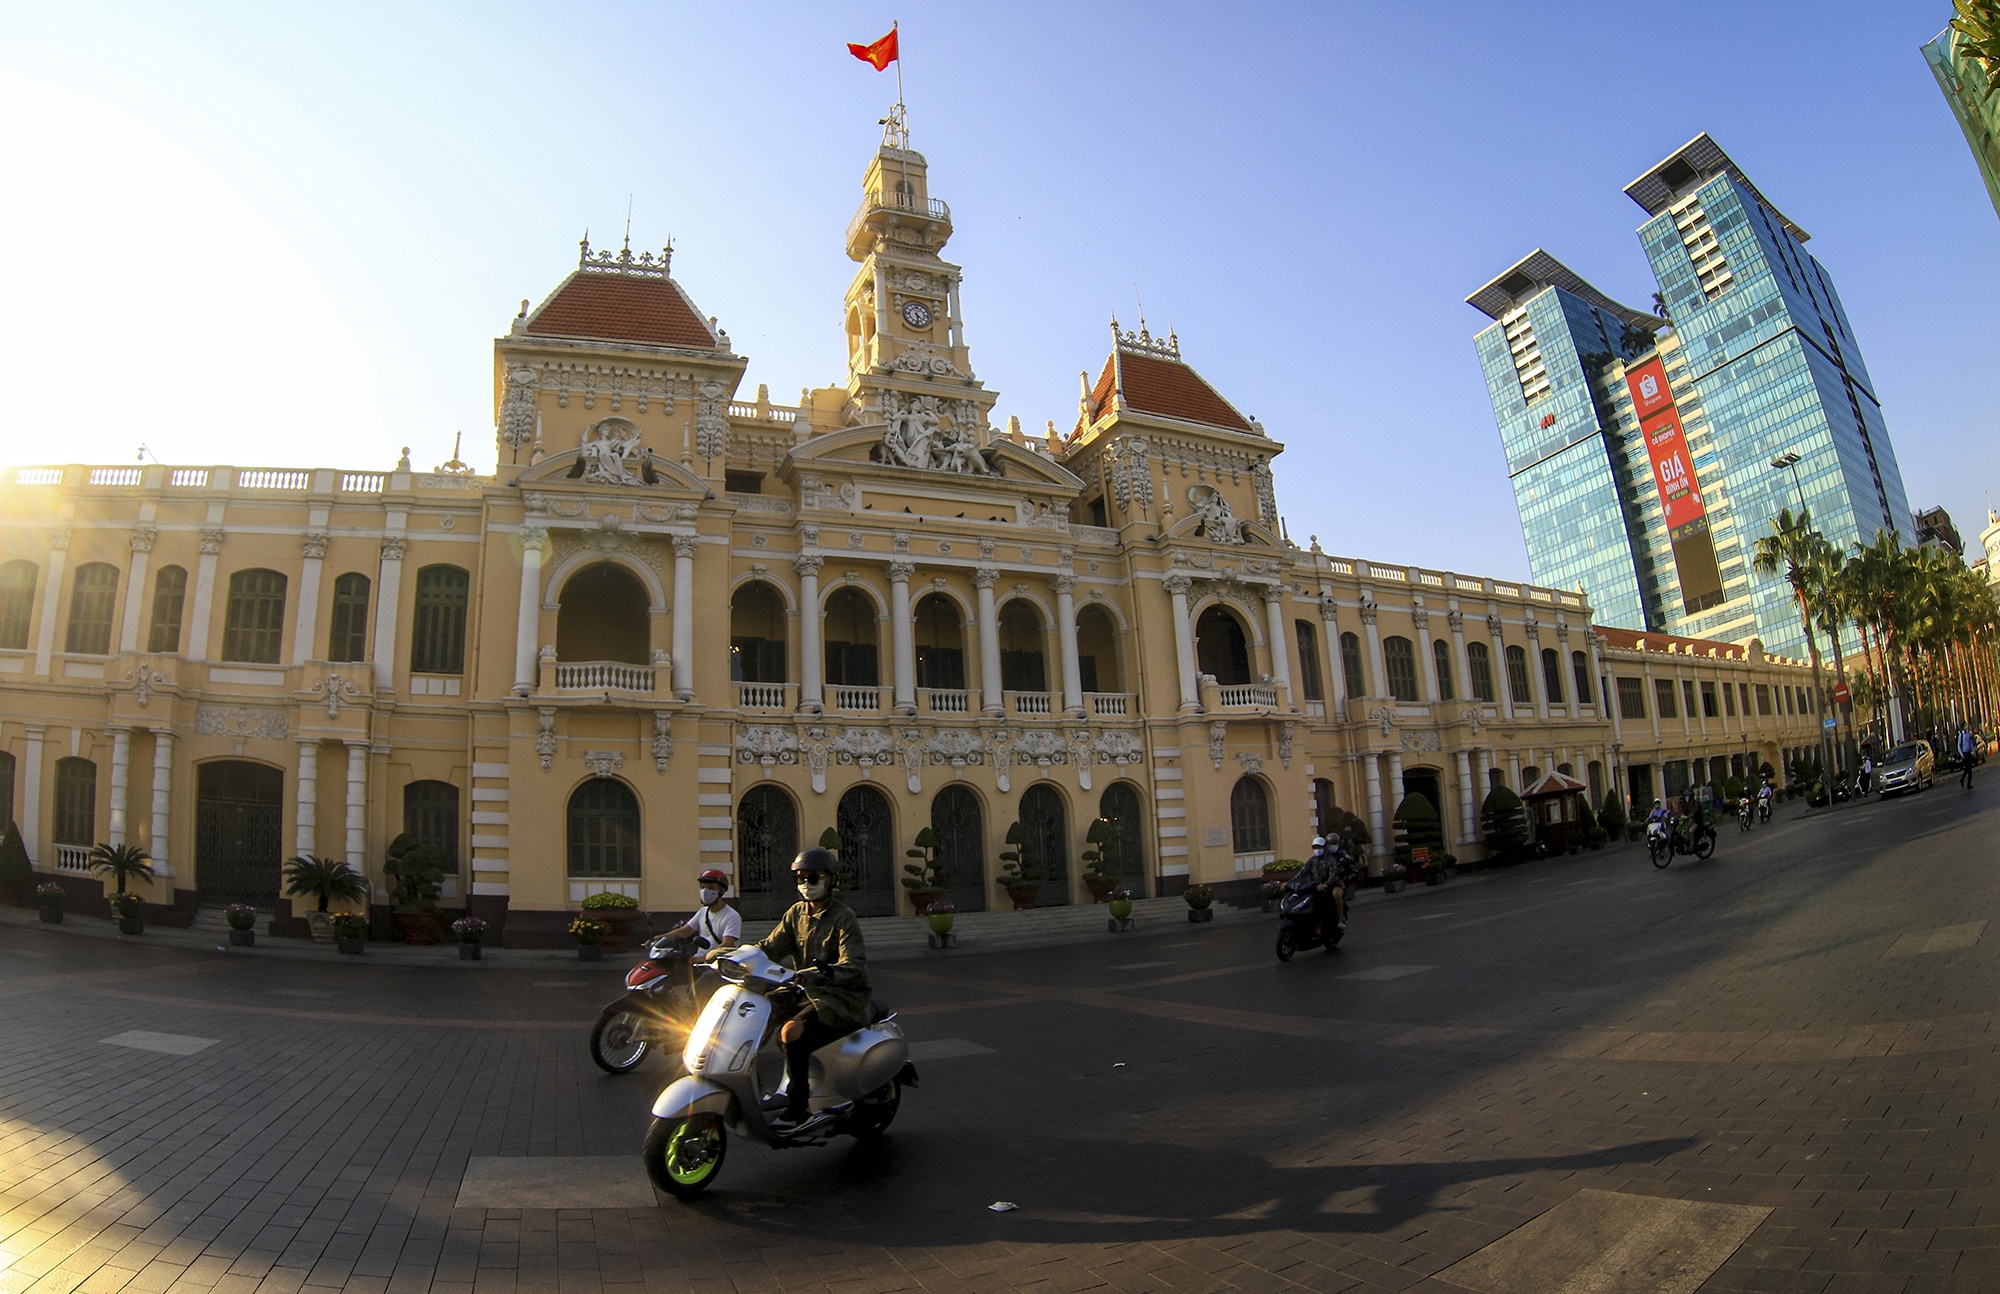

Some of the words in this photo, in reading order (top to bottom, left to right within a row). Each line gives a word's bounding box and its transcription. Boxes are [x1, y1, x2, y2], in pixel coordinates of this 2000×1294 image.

[1644, 395, 1662, 407] Shopee
[1660, 450, 1685, 482] GIÁ
[1665, 481, 1680, 495] BÌNH
[1987, 540, 2000, 556] RKS
